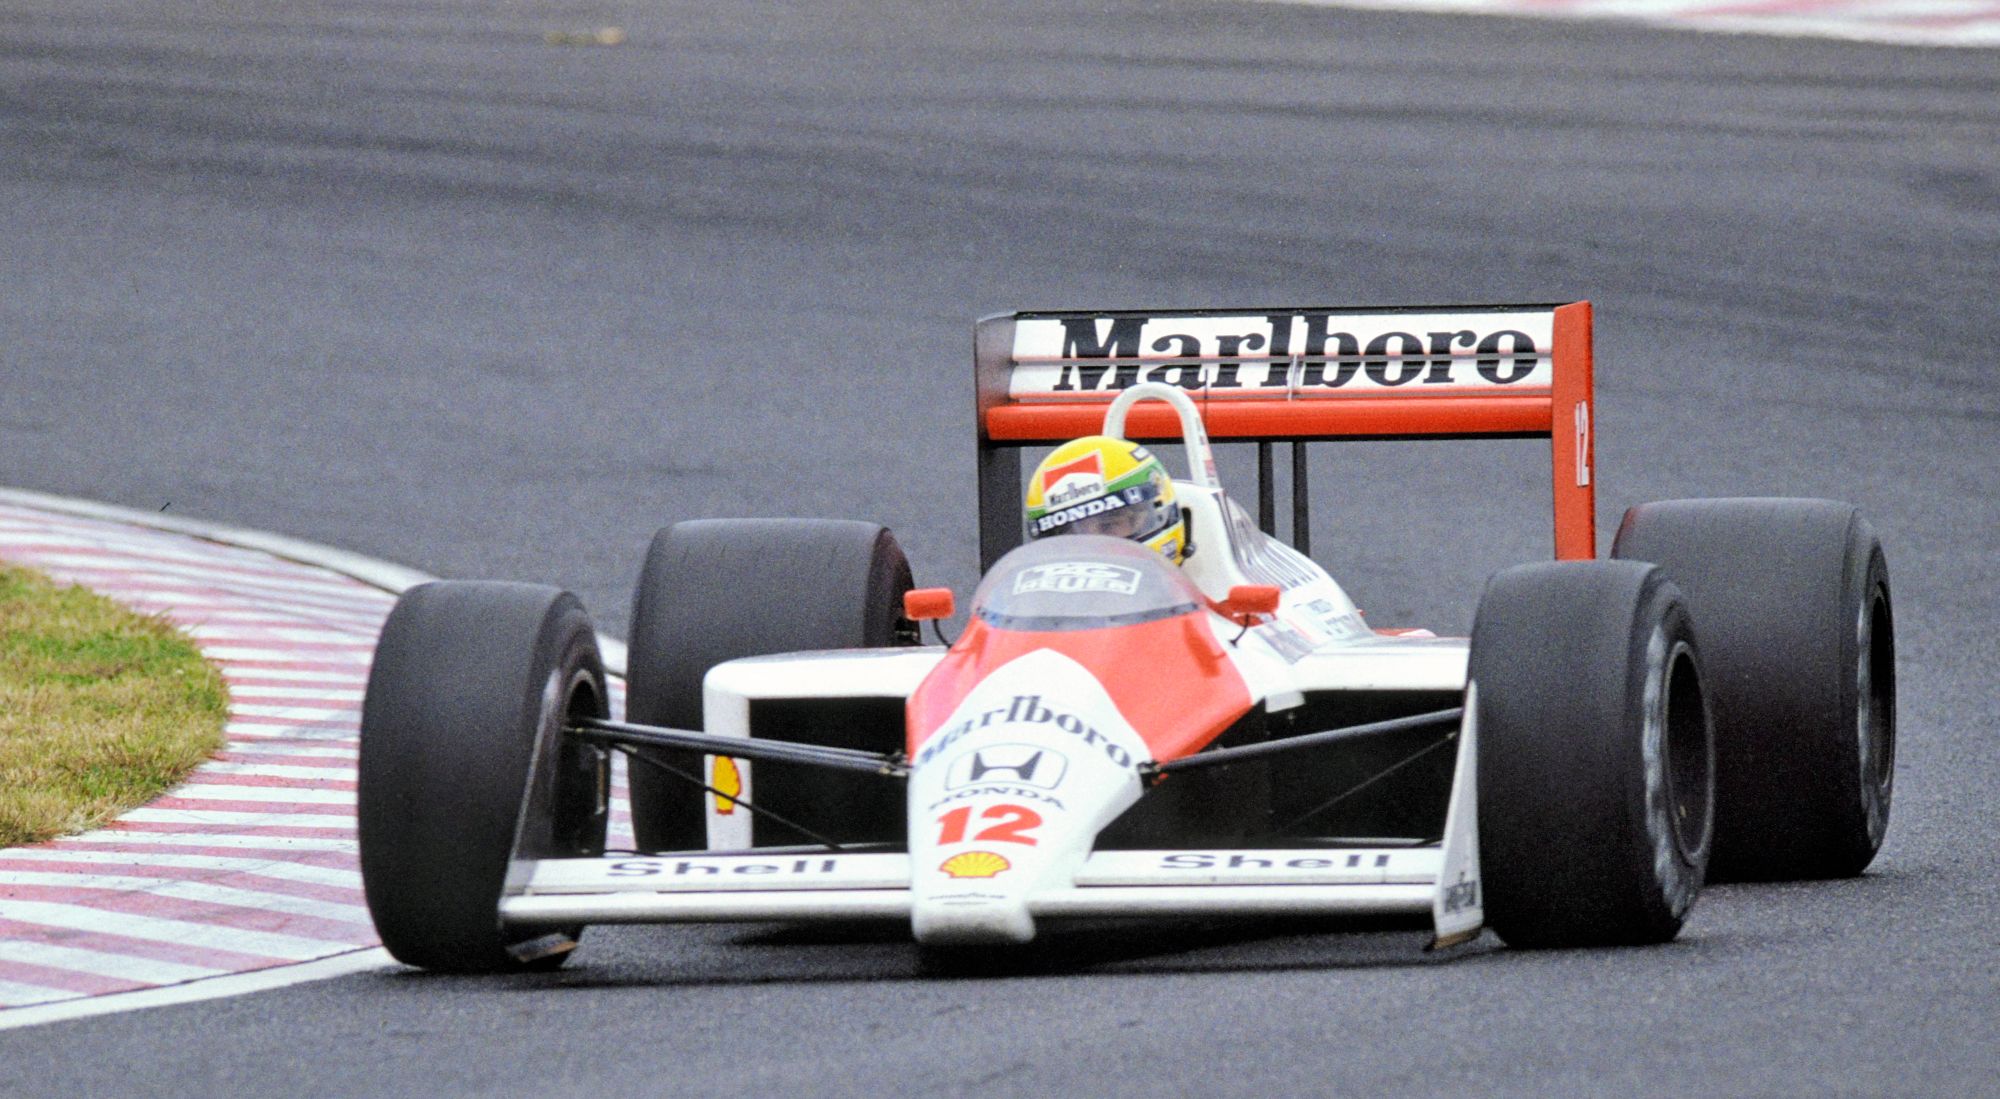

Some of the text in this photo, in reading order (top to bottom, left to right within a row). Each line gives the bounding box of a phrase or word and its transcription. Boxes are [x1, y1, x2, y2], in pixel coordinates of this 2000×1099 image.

[1053, 315, 1538, 390] Marlboro
[1575, 400, 1589, 486] 12
[1038, 495, 1125, 532] HONDA
[914, 695, 1132, 770] Marlboro
[937, 804, 1043, 847] 12
[607, 859, 836, 877] Shell
[1160, 854, 1390, 869] Shell
